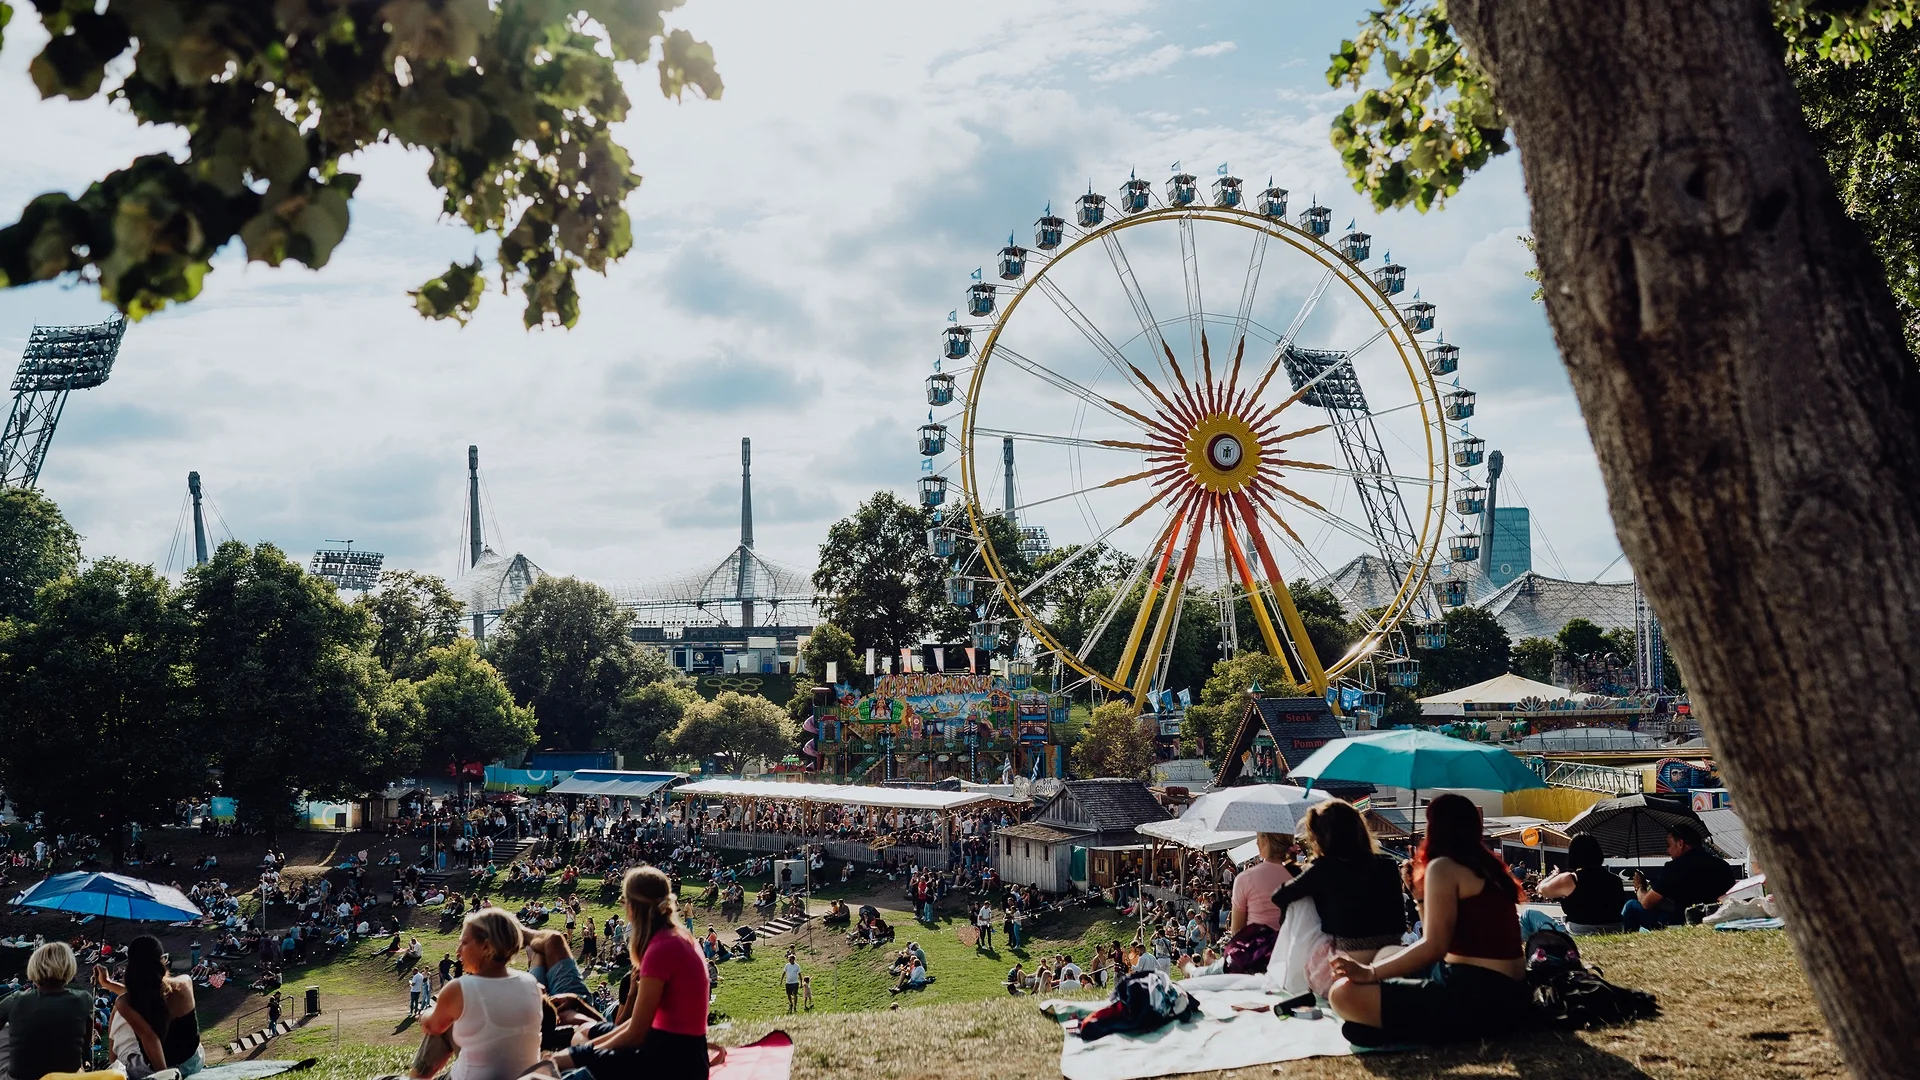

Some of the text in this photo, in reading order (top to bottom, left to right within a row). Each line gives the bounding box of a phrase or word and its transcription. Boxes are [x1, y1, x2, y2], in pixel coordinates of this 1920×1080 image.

[876, 673, 992, 697] ALPENRAUSCH
[1286, 713, 1312, 722] Steak
[1293, 739, 1328, 749] Pomme
